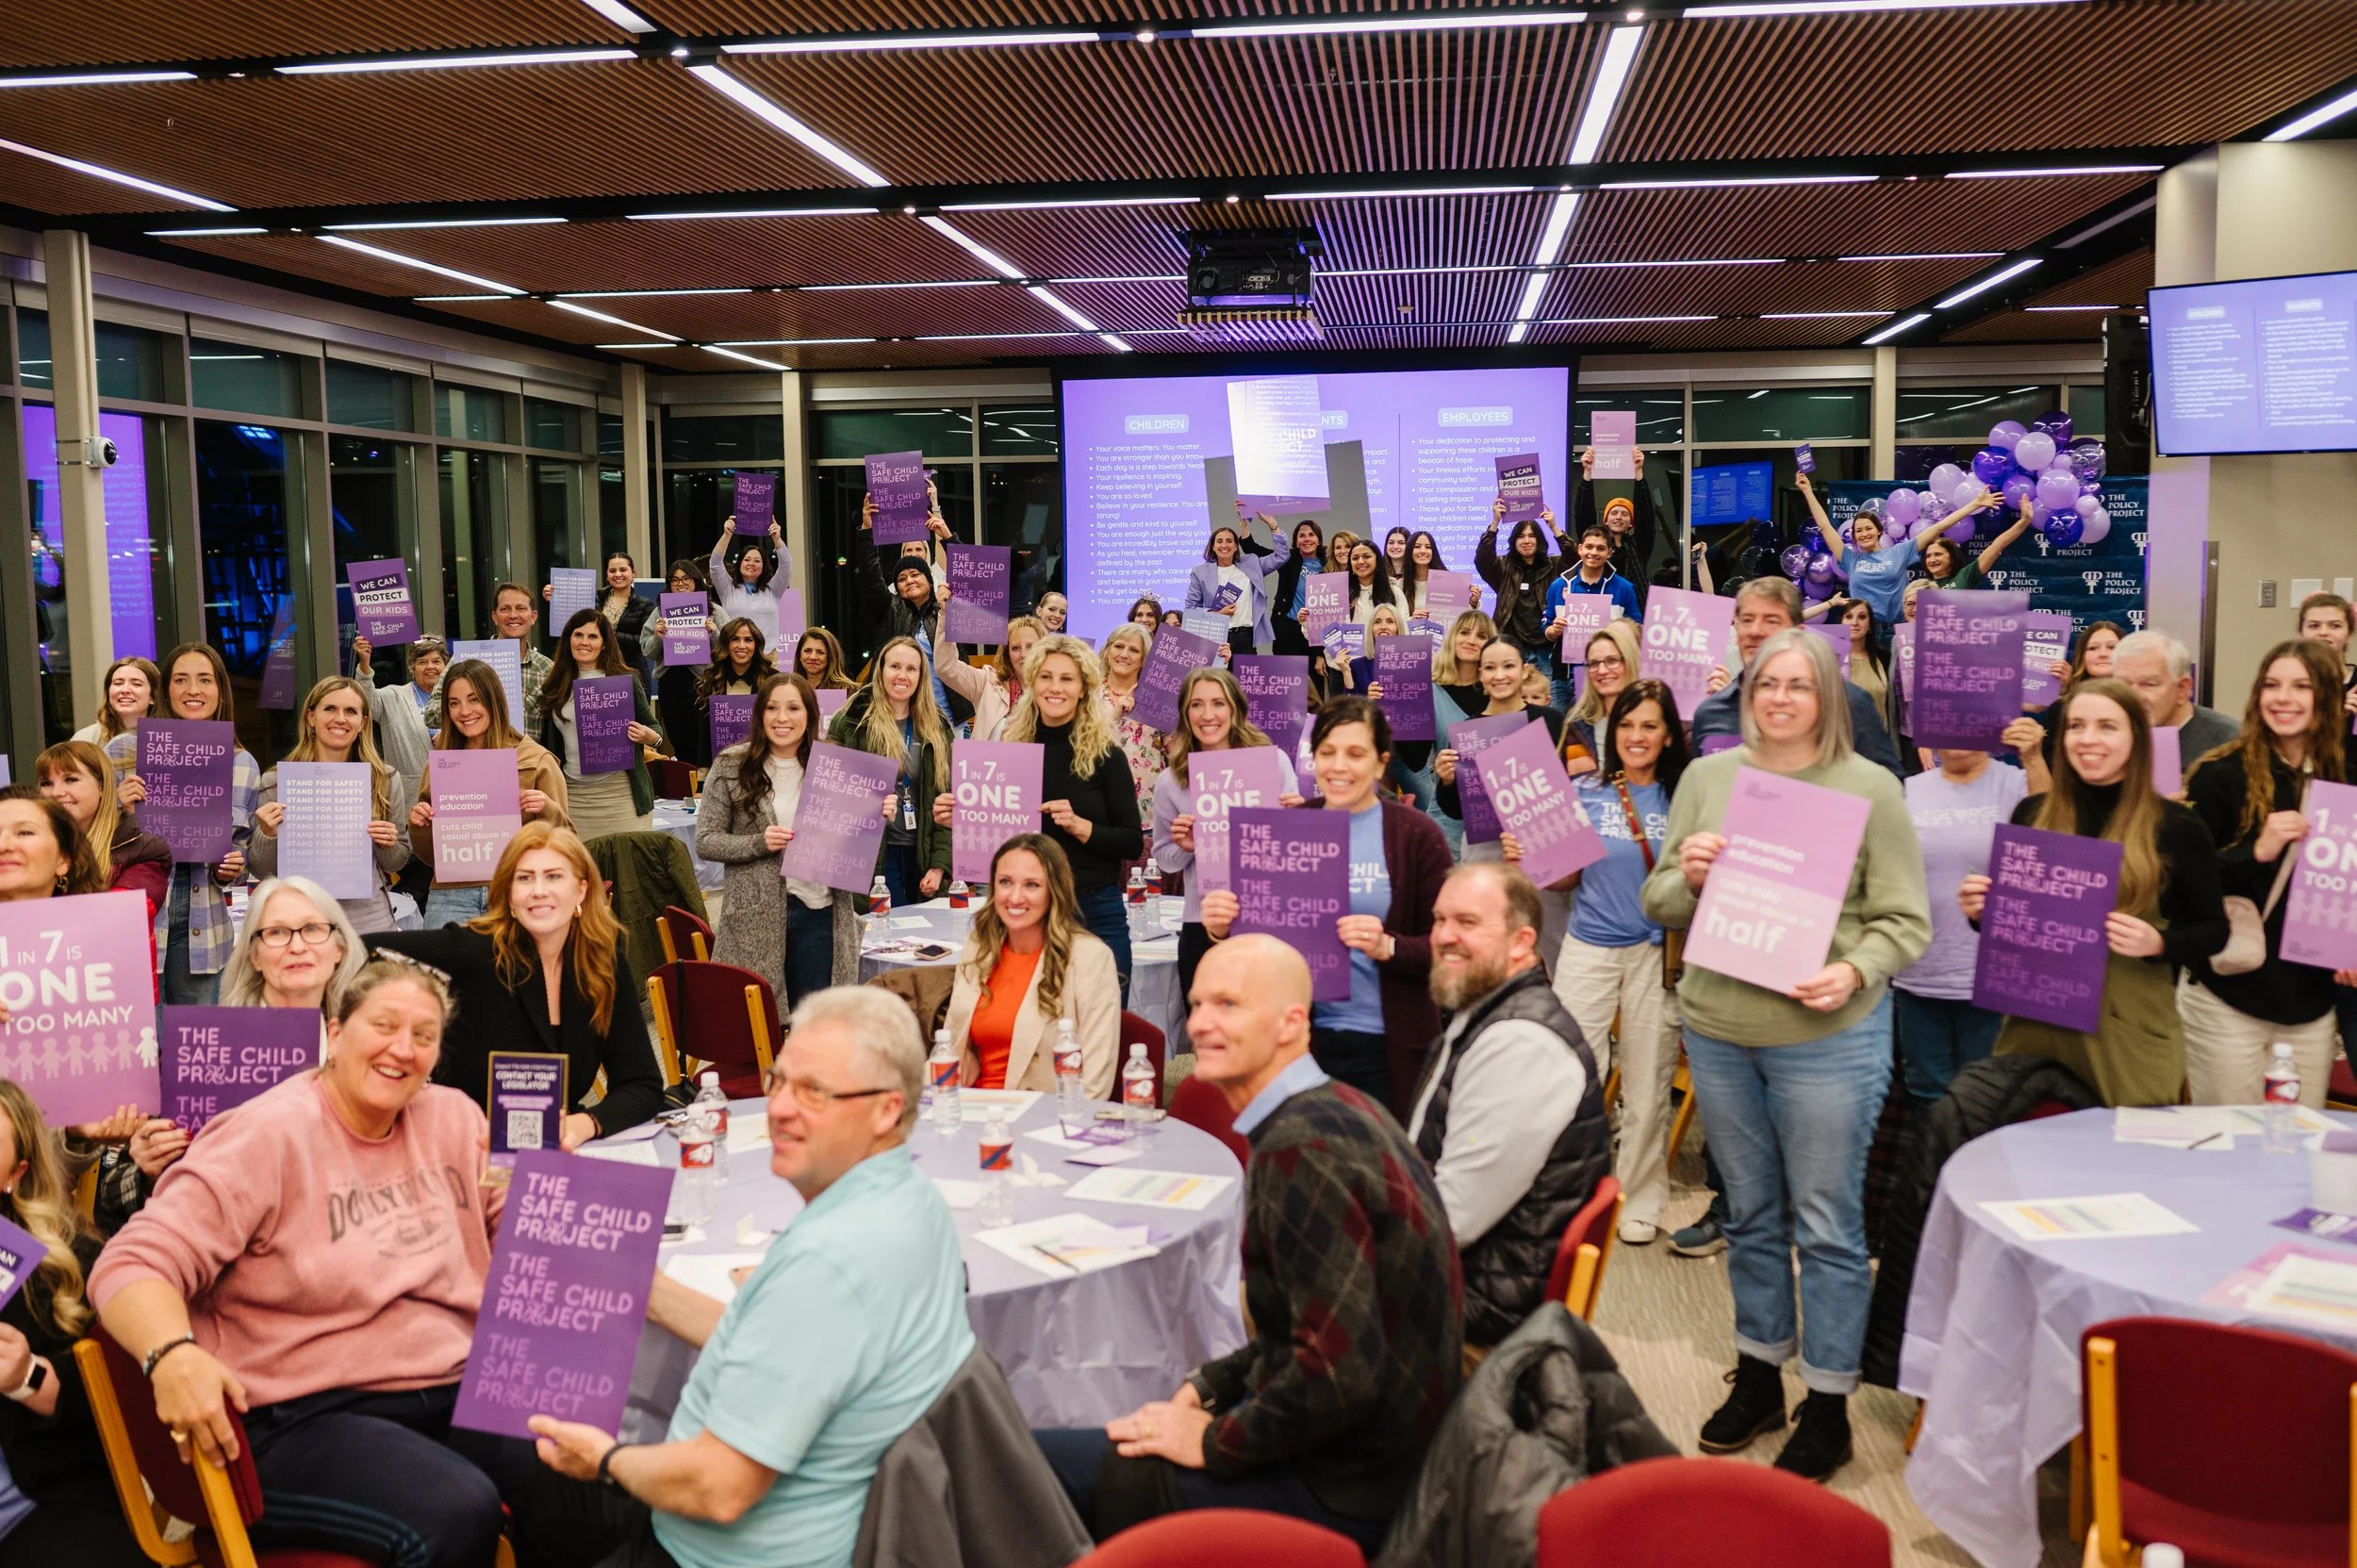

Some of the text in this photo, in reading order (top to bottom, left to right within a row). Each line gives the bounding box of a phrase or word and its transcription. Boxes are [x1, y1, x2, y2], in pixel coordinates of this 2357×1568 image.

[1129, 420, 1185, 430] CHILDREN
[1442, 412, 1508, 422] EMPLOYEES
[1518, 467, 1532, 475] CAN
[1595, 458, 1621, 468] half
[1503, 478, 1536, 487] PROTECT
[2109, 509, 2144, 518] PROJECT
[953, 561, 975, 569] SAFE
[360, 577, 396, 590] WE CAN
[360, 591, 402, 602] PROTECT
[1308, 594, 1339, 607] ONE
[684, 606, 700, 615] CAN
[1925, 604, 1956, 618] THE
[1568, 614, 1600, 626] ONE
[1924, 619, 2018, 632] SAFE CHILD
[1162, 634, 1178, 644] THE
[1647, 624, 1710, 651] ONE
[1158, 642, 1208, 664] SAFE CHILD
[1647, 649, 1715, 665] TOO MANY
[580, 694, 600, 702] SAFE
[147, 732, 173, 742] THE
[147, 743, 224, 754] SAFE CHILD
[818, 755, 841, 769] THE
[959, 759, 1005, 781] 1 IN 7 IS
[815, 766, 886, 791] SAFE CHILD
[1486, 757, 1517, 789] 1 7
[439, 793, 487, 801] prevention
[957, 783, 1022, 810] ONE
[1495, 768, 1553, 814] ONE
[440, 802, 484, 811] education
[1506, 790, 1565, 830] TOO MANY
[959, 810, 1030, 826] TOO MANY
[1240, 824, 1271, 839] THE
[442, 842, 493, 863] half
[1240, 839, 1340, 857] SAFE CHILD
[1730, 834, 1805, 862] prevention
[2003, 841, 2039, 860] THE
[1727, 850, 1794, 875] education
[2000, 856, 2108, 888] SAFE CHILD
[2304, 870, 2347, 893] TOO
[1705, 906, 1786, 954] half
[17, 950, 35, 966] IN
[40, 931, 63, 963] 7
[66, 947, 81, 959] IS
[0, 963, 116, 1011] ONE
[4, 1005, 133, 1035] TOO MANY
[178, 1027, 220, 1045] THE
[177, 1047, 306, 1065] SAFE CHILD
[527, 1173, 569, 1197] THE
[328, 1165, 469, 1243] DOLYOD
[519, 1195, 652, 1233] SAFE CHILD
